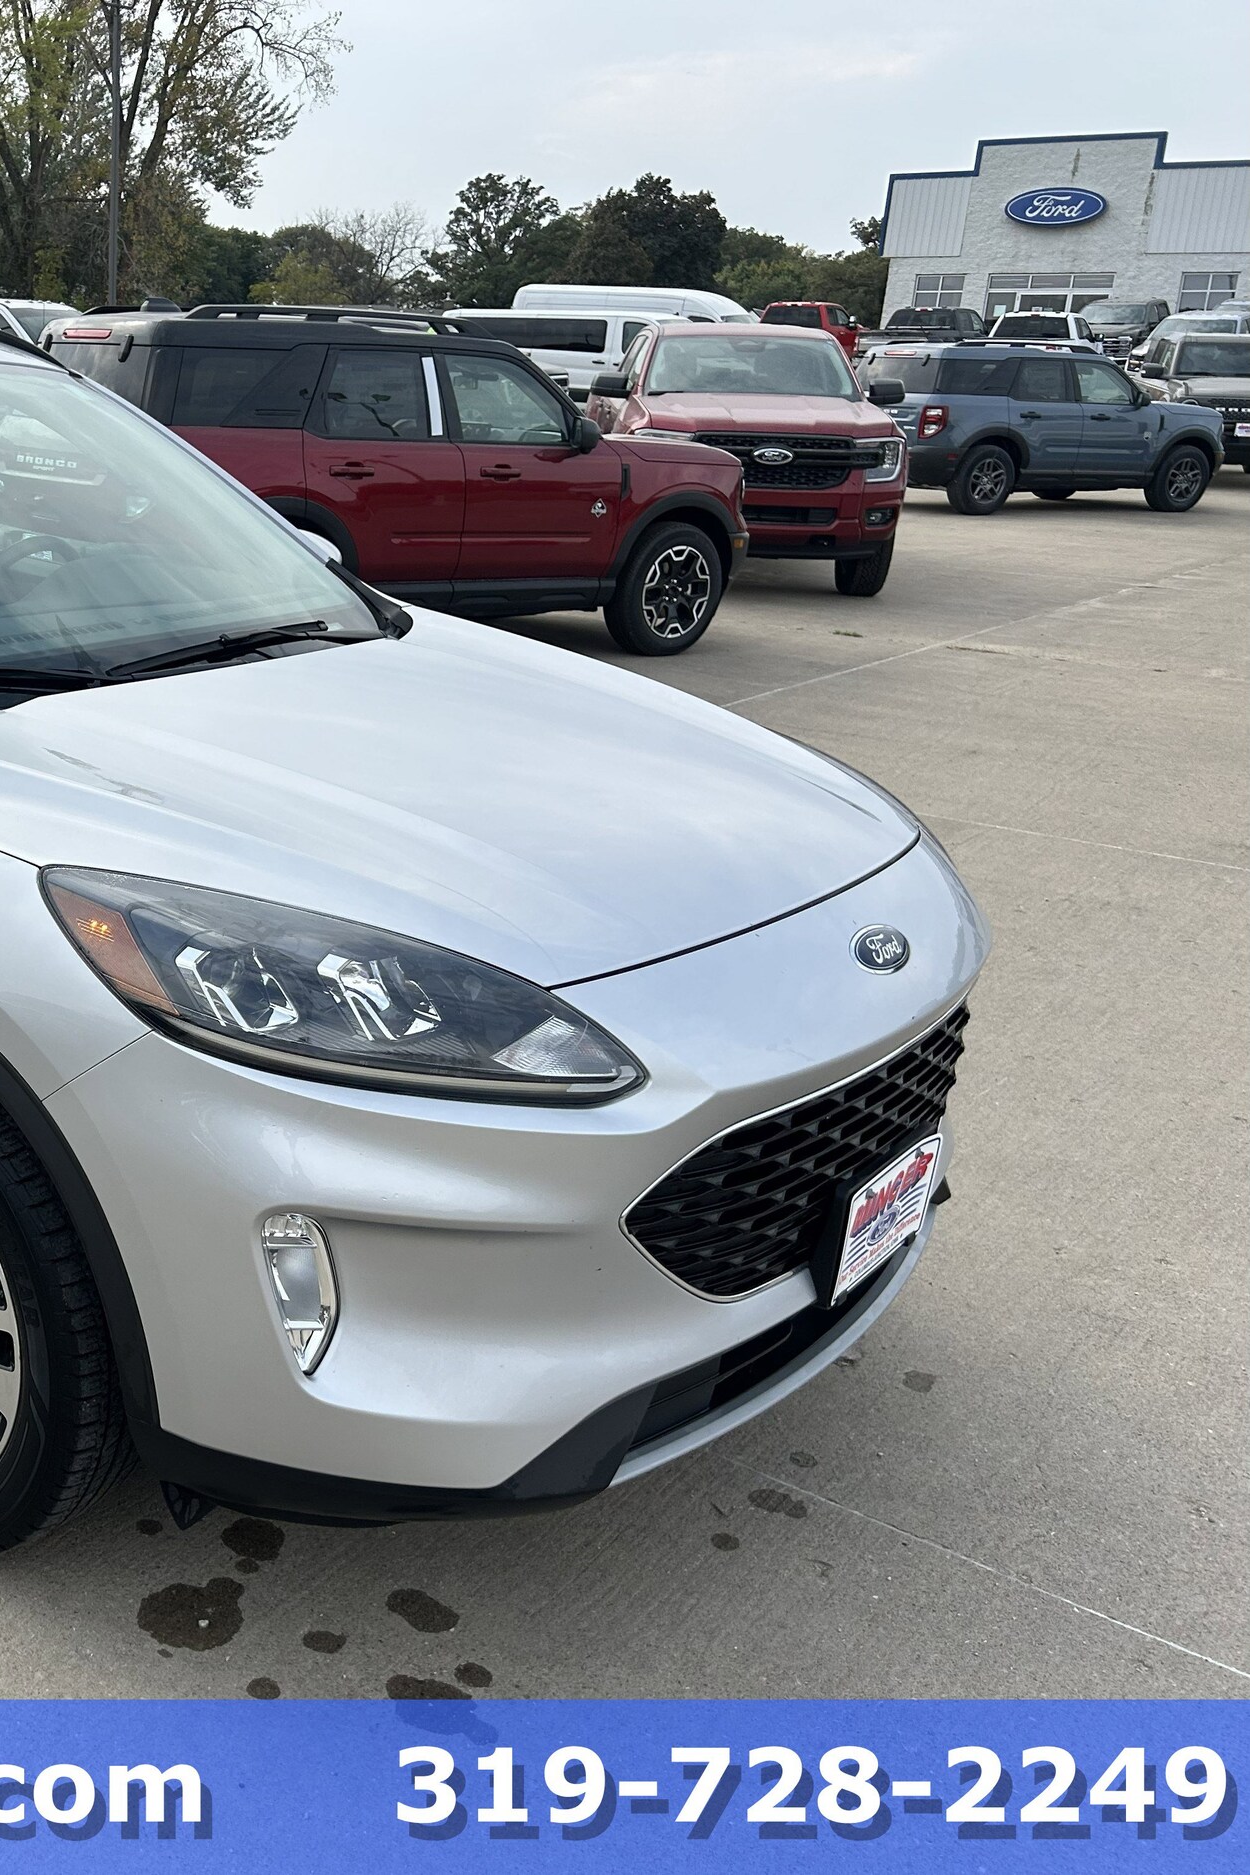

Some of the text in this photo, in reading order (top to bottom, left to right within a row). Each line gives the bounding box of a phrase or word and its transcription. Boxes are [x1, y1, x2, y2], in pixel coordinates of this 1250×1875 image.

[1025, 194, 1085, 218] Ford
[16, 455, 77, 469] BRONCO
[865, 933, 902, 964] Ford
[851, 1152, 934, 1238] MINCER
